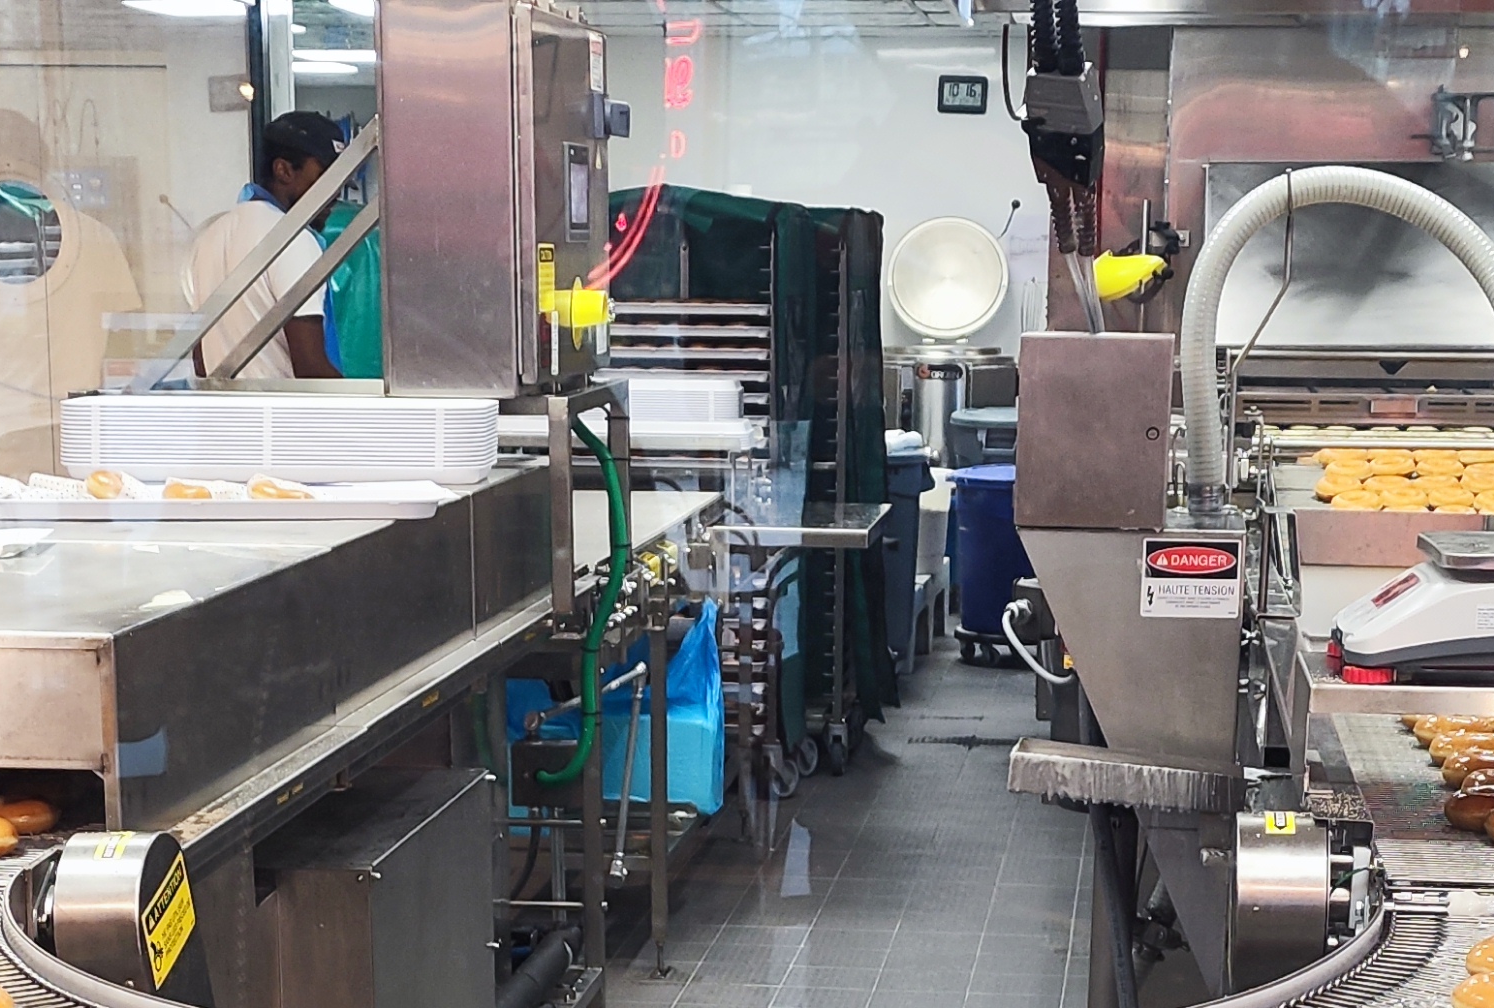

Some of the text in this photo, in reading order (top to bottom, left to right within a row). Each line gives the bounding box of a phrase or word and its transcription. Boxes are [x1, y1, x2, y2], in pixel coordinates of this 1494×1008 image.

[1170, 554, 1228, 567] DANGER
[1158, 584, 1235, 596] HAUTE TENSION
[153, 864, 183, 921] ATTENTION
